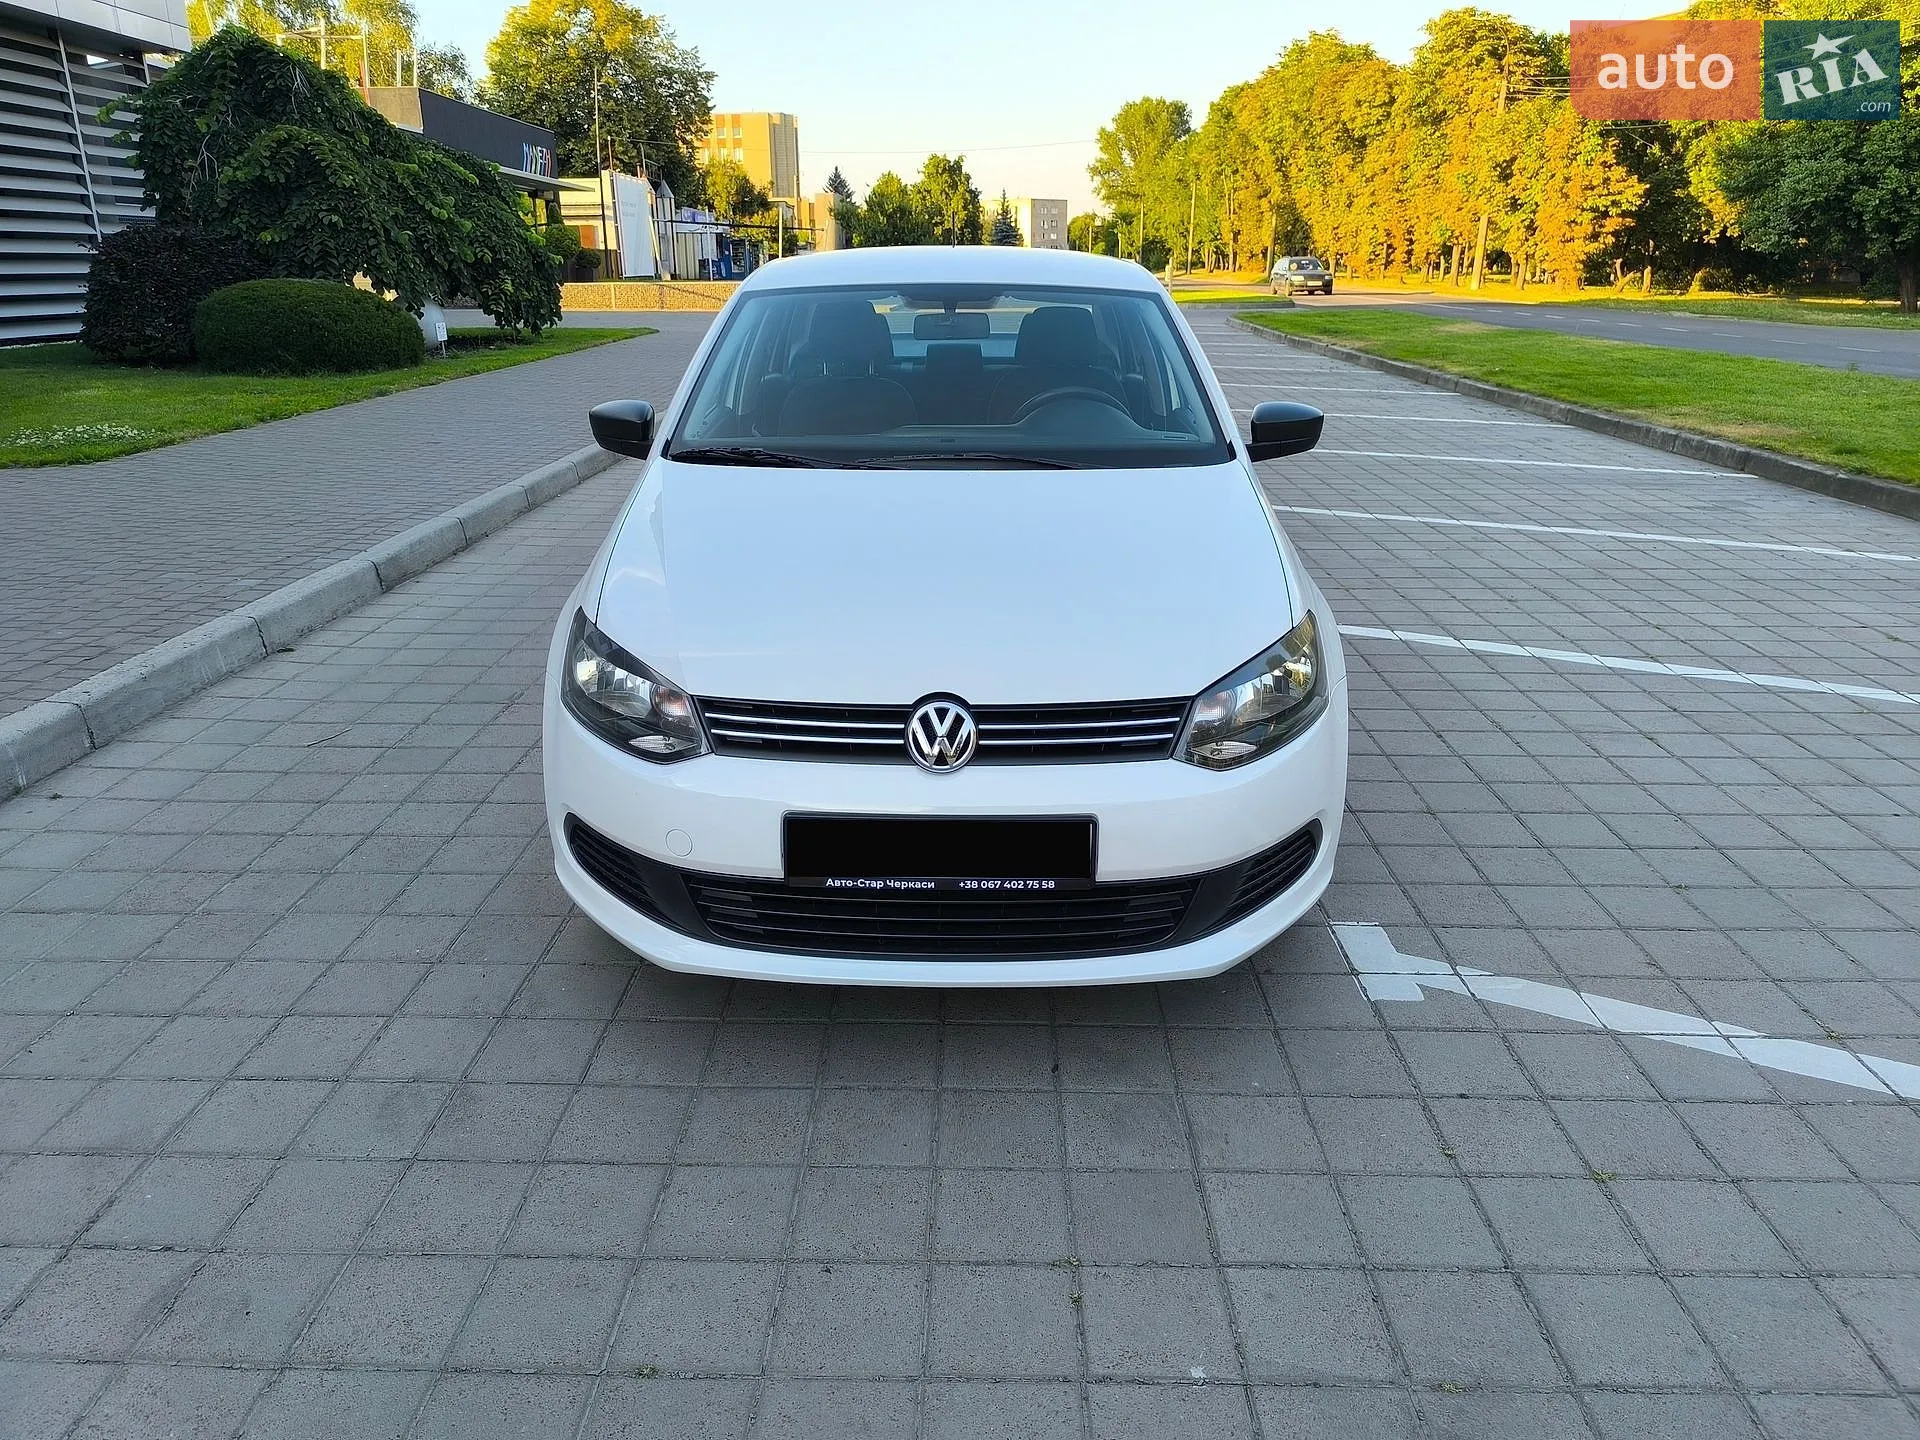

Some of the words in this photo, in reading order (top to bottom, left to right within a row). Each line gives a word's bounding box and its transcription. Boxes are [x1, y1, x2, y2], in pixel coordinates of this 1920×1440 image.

[825, 878, 885, 890] Авто-Стар
[886, 879, 935, 890] Черкаси
[959, 880, 979, 889] +38
[980, 880, 1001, 889] 067
[1003, 880, 1025, 889] 402
[1026, 880, 1040, 889] 75
[1041, 880, 1055, 889] 58
